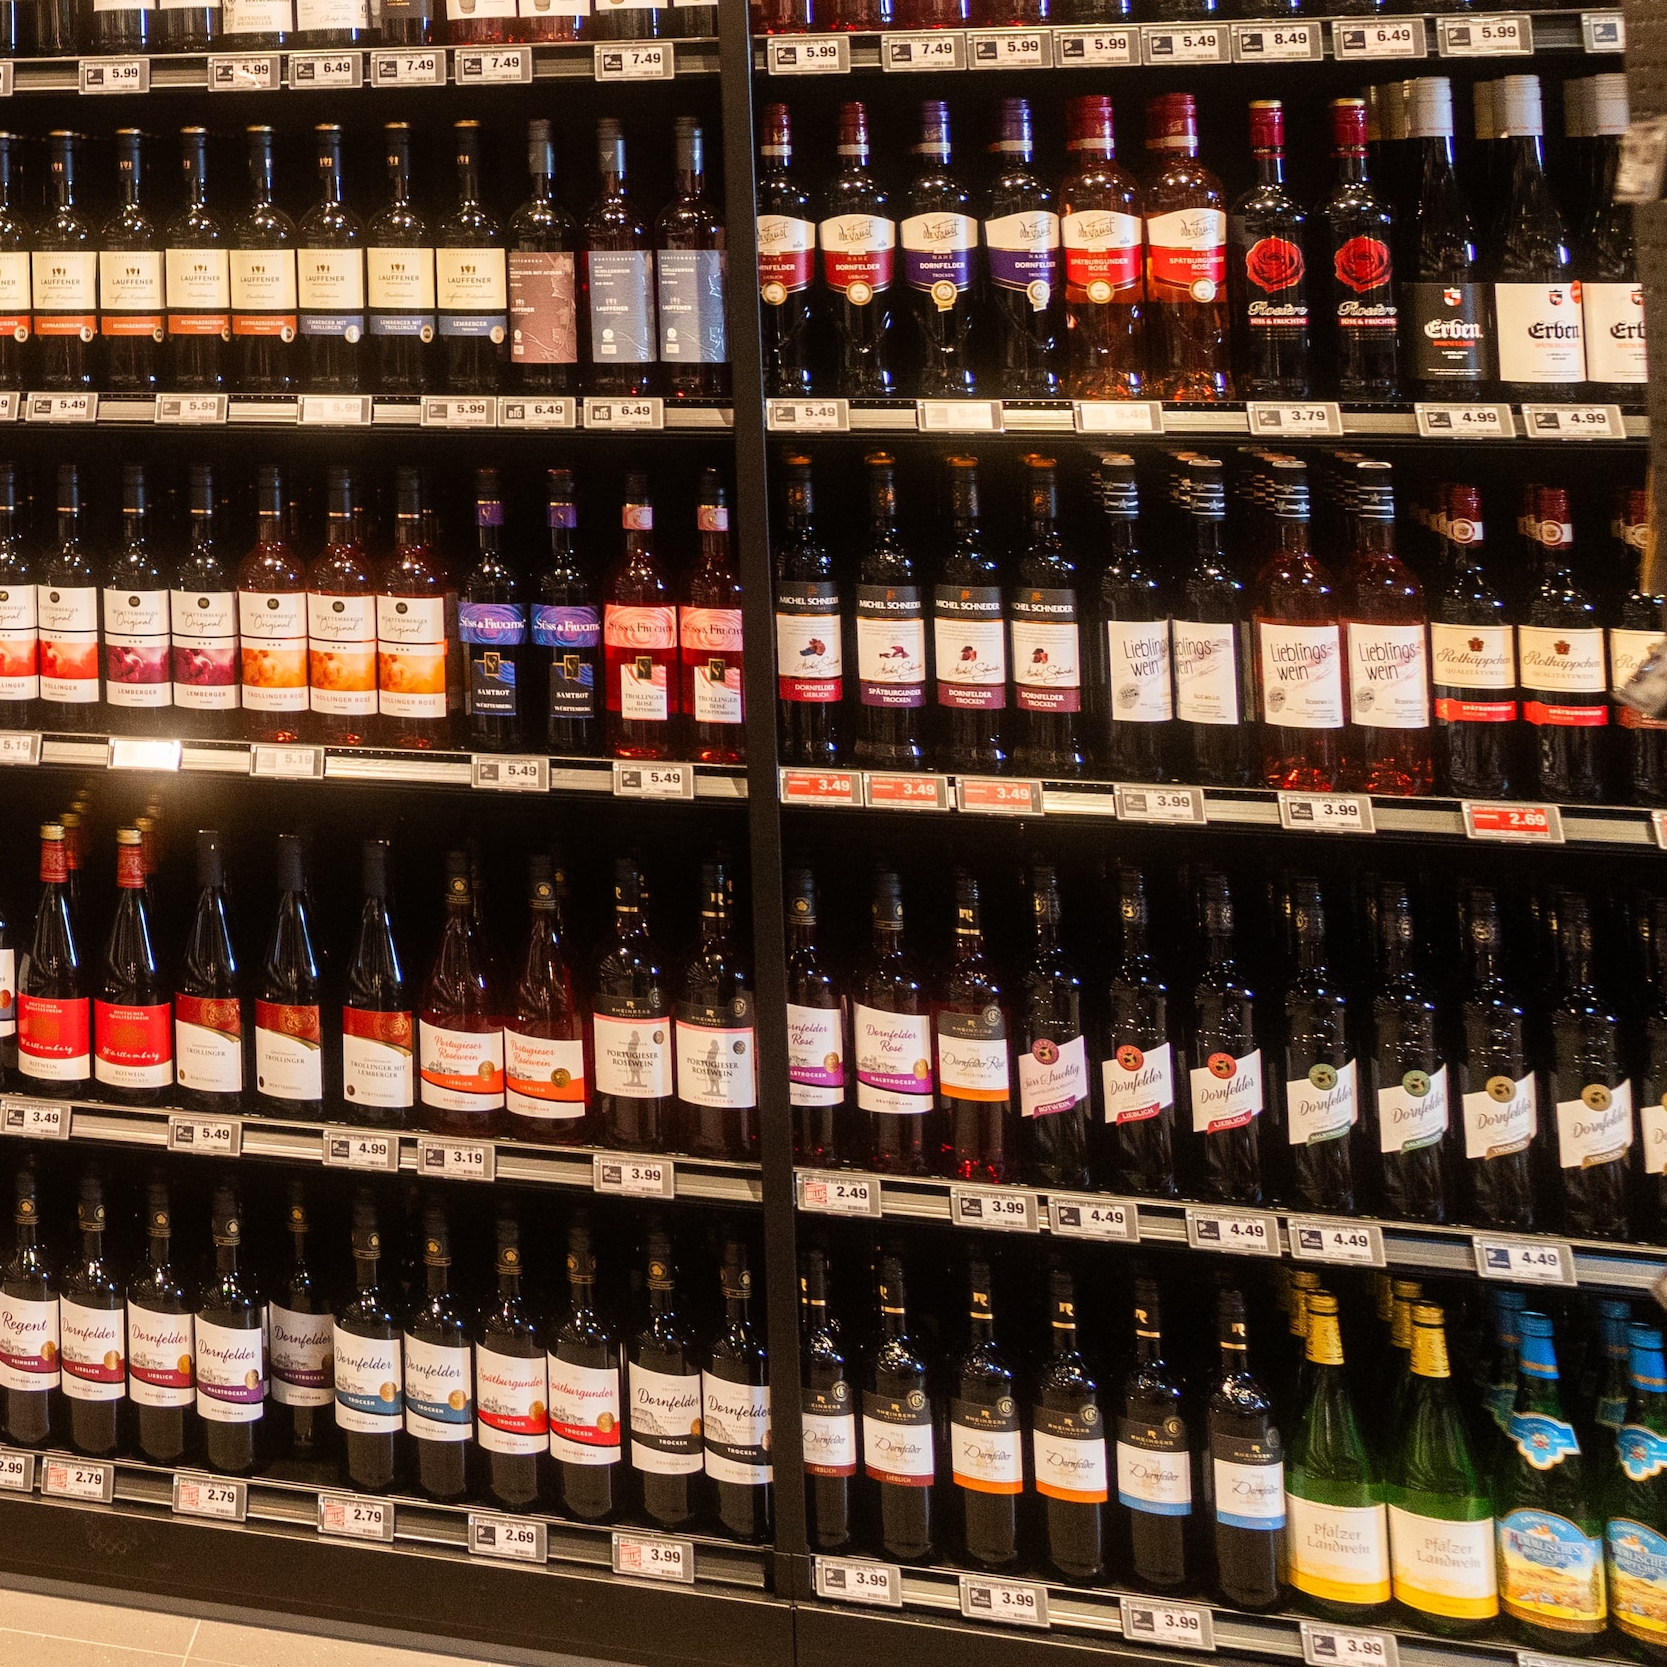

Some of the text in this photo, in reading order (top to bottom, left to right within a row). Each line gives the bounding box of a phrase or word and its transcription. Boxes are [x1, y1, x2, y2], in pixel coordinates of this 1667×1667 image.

[1274, 32, 1307, 45] 8.49
[1377, 29, 1410, 42] 6.49
[922, 43, 952, 55] 7.49
[632, 53, 661, 64] 7.49
[1070, 256, 1128, 266] SPÄTBURGUNDER
[447, 276, 492, 284] LAUFFENER
[621, 406, 650, 416] 6.49
[1292, 410, 1325, 421] 3.79
[1269, 642, 1333, 663] Lieblings-
[1436, 647, 1511, 668] Rotkäppchen
[1277, 662, 1310, 681] wein
[117, 688, 158, 697] LEMBERGER
[556, 691, 589, 699] SAMTROT
[949, 689, 992, 698] DORNFELDER
[956, 697, 986, 705] TROCKEN
[508, 766, 537, 776] 5.49
[818, 779, 850, 792] 3.49
[1509, 813, 1546, 826] 2.69
[434, 1034, 483, 1050] Portugieser
[186, 1048, 227, 1057] TROLLINGER
[606, 1050, 659, 1060] PORTUGIESER
[1108, 1070, 1163, 1096] Dornfelder
[1038, 1101, 1071, 1114] ROTWEIN
[1121, 1107, 1155, 1120] LIEBLICH
[453, 1151, 483, 1164] 3.19
[1090, 1210, 1124, 1224] 4.49
[2, 1311, 49, 1333] Regent
[62, 1317, 117, 1341] Dornfelder
[478, 1366, 544, 1389] Spätburgunder
[497, 1417, 526, 1427] TROCKEN
[505, 1529, 535, 1544] 2.69
[1314, 1524, 1362, 1542] Pfälzer
[1306, 1536, 1370, 1557] Landwein
[1002, 1592, 1034, 1607] 3.99
